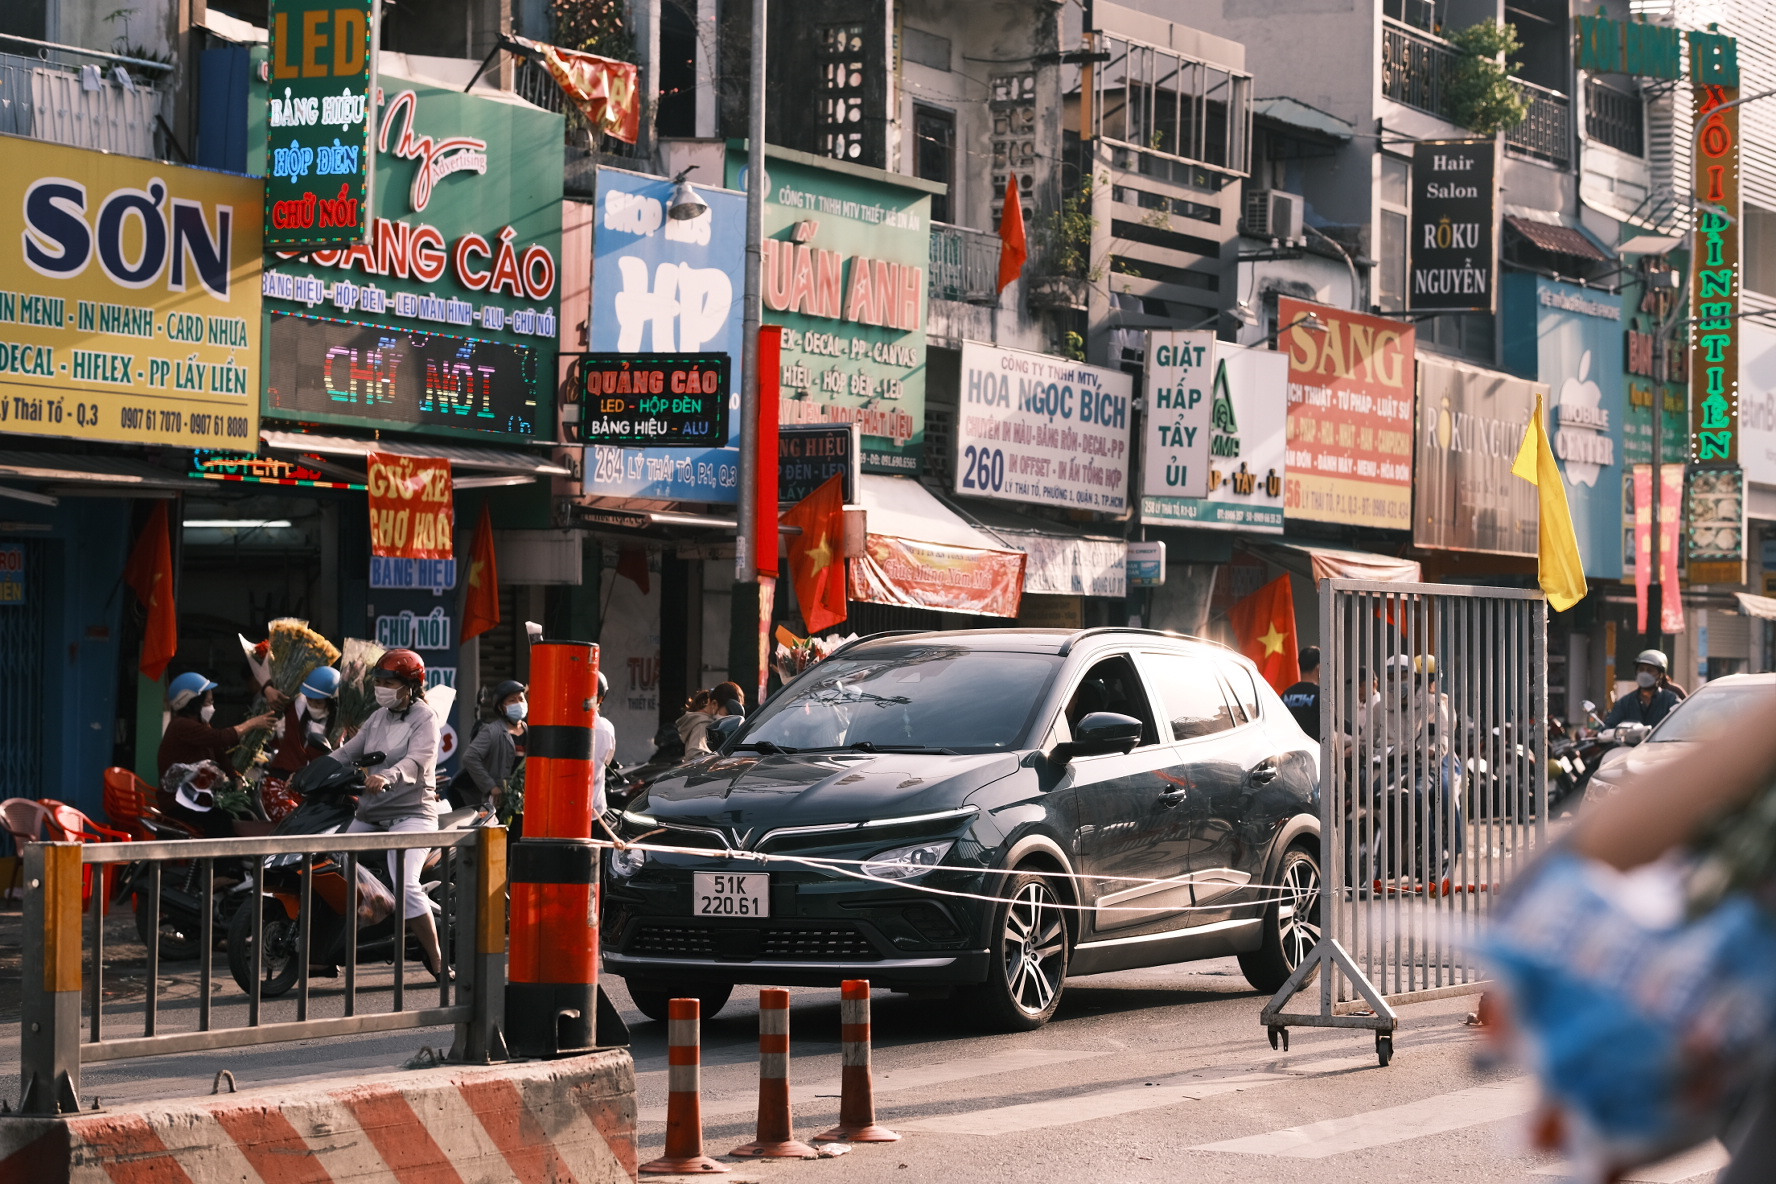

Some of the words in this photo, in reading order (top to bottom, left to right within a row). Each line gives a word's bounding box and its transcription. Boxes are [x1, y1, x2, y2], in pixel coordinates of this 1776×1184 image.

[273, 8, 366, 79] LED
[270, 87, 319, 126] BẢNG
[322, 88, 366, 131] HIỆU
[274, 139, 313, 183] HỘP
[316, 138, 359, 175] ĐÈN
[432, 149, 487, 187] Advertising
[1433, 155, 1474, 171] Hair
[273, 192, 316, 229] CHỮ
[319, 183, 357, 228] NỔI
[779, 185, 803, 208] CÔNG
[805, 193, 815, 209] TY
[819, 196, 841, 216] TNHH
[843, 201, 860, 218] MTV
[1427, 182, 1478, 198] Salon
[22, 177, 233, 302] SƠN
[453, 225, 556, 300] CÁO
[763, 219, 842, 319] UẤN
[848, 256, 922, 332] ANH
[1415, 257, 1486, 294] NGUYỄN
[19, 293, 65, 329] MENU
[77, 301, 95, 331] IN
[98, 303, 154, 338] NHANH
[167, 313, 204, 343] CARD
[207, 317, 248, 352] NHỰA
[294, 274, 324, 308] HIỆU
[335, 279, 359, 313] HỘP
[361, 283, 387, 314] ĐÈN
[395, 291, 417, 319] LED
[419, 292, 446, 322] MÀN
[447, 296, 472, 325] HÌNH
[483, 306, 504, 331] ALU
[513, 309, 536, 335] CHỮ
[537, 307, 556, 338] NỔI
[804, 332, 841, 356] DECAL
[851, 336, 867, 359] PP
[873, 342, 917, 368] CANVAS
[1156, 341, 1206, 373] GIẶT
[1290, 310, 1405, 388] SANG
[0, 342, 54, 377] DECAL
[71, 350, 134, 385] HIFLEX
[148, 357, 170, 388] PP
[174, 354, 206, 393] LẤY
[211, 357, 247, 396] LIỀN
[587, 362, 664, 396] QUẢNG
[671, 366, 718, 394] CÁO
[783, 360, 812, 391] HIỆU
[824, 365, 848, 399] HỘP
[850, 367, 875, 397] ĐÈN
[882, 379, 904, 399] LED
[1001, 355, 1028, 375] CÔNG
[1032, 363, 1044, 377] TY
[1049, 365, 1074, 382] TNHH
[1077, 371, 1099, 387] MTV
[0, 396, 9, 421] ý
[14, 397, 42, 421] Thái
[48, 397, 64, 423] Tổ
[77, 403, 98, 427] Q.3
[600, 399, 625, 413] LED
[640, 396, 669, 416] HỘP
[672, 396, 702, 413] ĐÈN
[968, 368, 1010, 409] HOA
[1018, 377, 1073, 423] NGỌC
[1080, 382, 1126, 430] BÍCH
[1157, 377, 1202, 410] HẤP
[1288, 383, 1302, 407] ỊCH
[1305, 384, 1332, 412] THUẬT
[1377, 396, 1398, 422] LUẬT
[121, 407, 143, 430] 0907
[146, 408, 156, 431] 61
[160, 411, 181, 433] 7070
[190, 413, 211, 435] 0907
[214, 415, 224, 436] 61
[227, 417, 248, 438] 8080
[592, 416, 630, 435] BẢNG
[634, 417, 667, 437] HIỆU
[682, 421, 709, 435] ALU
[1158, 413, 1197, 447] TẨY
[1557, 404, 1610, 427] MOBILE
[805, 432, 846, 462] HIỆU
[966, 414, 1000, 441] CHUYÊN
[1002, 420, 1011, 442] IN
[1082, 433, 1108, 457] DECAL
[1111, 439, 1125, 460] PP
[1553, 430, 1614, 466] CENTER
[370, 458, 414, 500] GIỮ
[417, 468, 450, 503] XE
[594, 446, 624, 483] 264
[627, 453, 645, 480] LÝ
[647, 455, 675, 482] THÁI
[718, 464, 738, 487] Q.3
[786, 459, 812, 480] ĐÈN
[963, 445, 1004, 493] 260
[1009, 453, 1017, 473] IN
[1019, 455, 1051, 478] OFFSET
[1058, 461, 1067, 480] IN
[1165, 455, 1187, 487] ỦI
[1101, 495, 1124, 509] TP.HCM
[1284, 479, 1301, 508] 56
[370, 508, 410, 556] CHỢ
[414, 512, 451, 550] HOA
[883, 558, 912, 582] Chúc
[947, 567, 971, 587] Năm
[376, 611, 412, 649] CHỮ
[415, 607, 449, 649] NỔI
[1283, 694, 1315, 708] NOW
[714, 876, 746, 894] 51K
[702, 896, 758, 915] 220.61
